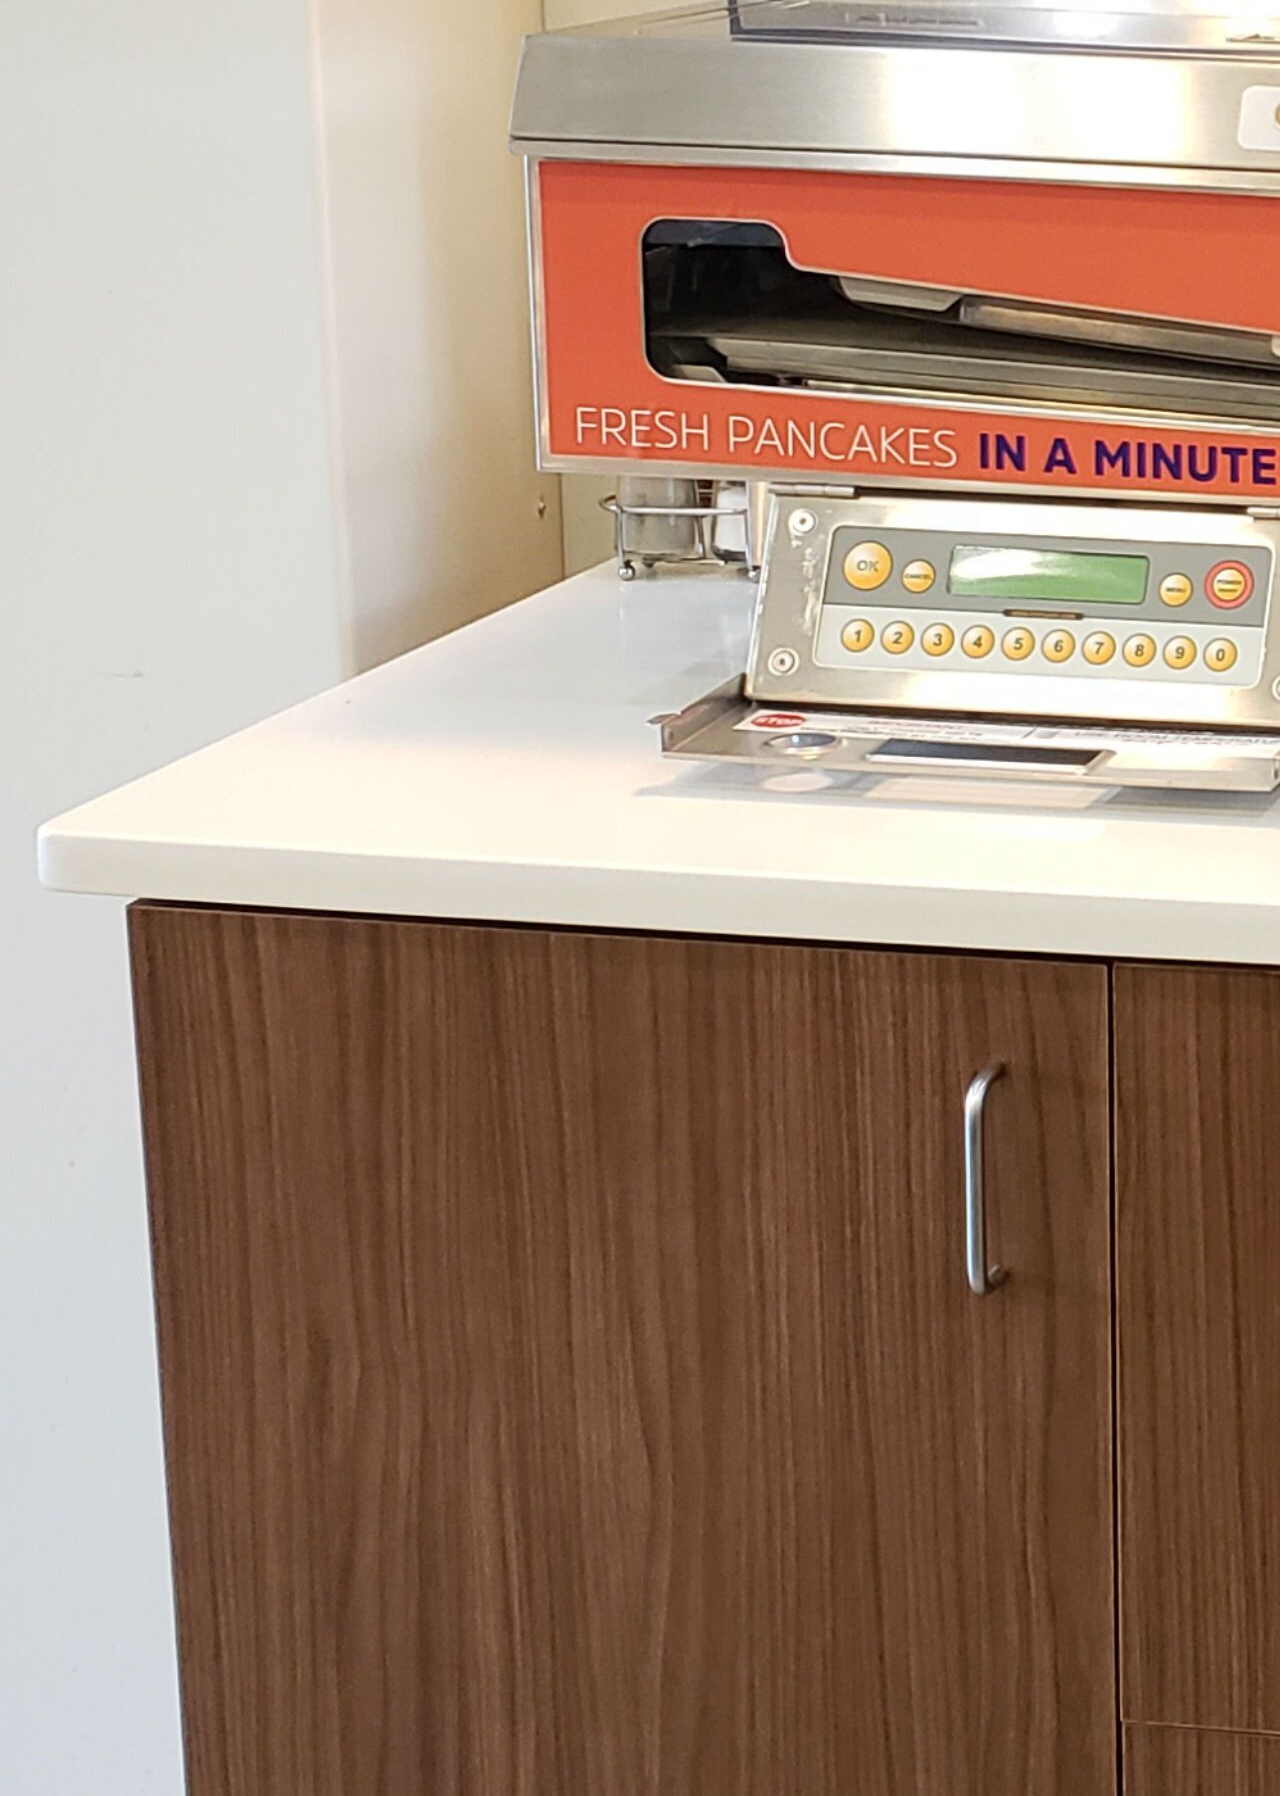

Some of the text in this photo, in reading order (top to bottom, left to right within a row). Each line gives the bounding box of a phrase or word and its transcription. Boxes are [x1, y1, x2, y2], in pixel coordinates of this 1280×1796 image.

[575, 406, 709, 451] FRESH
[728, 415, 958, 468] PANCAKES
[979, 433, 1026, 472] IN
[1043, 438, 1078, 474] A
[1094, 440, 1277, 485] MINUTE
[856, 559, 879, 572] OK
[854, 629, 1225, 662] 1 2 3 4 5 6 7 8 9 0
